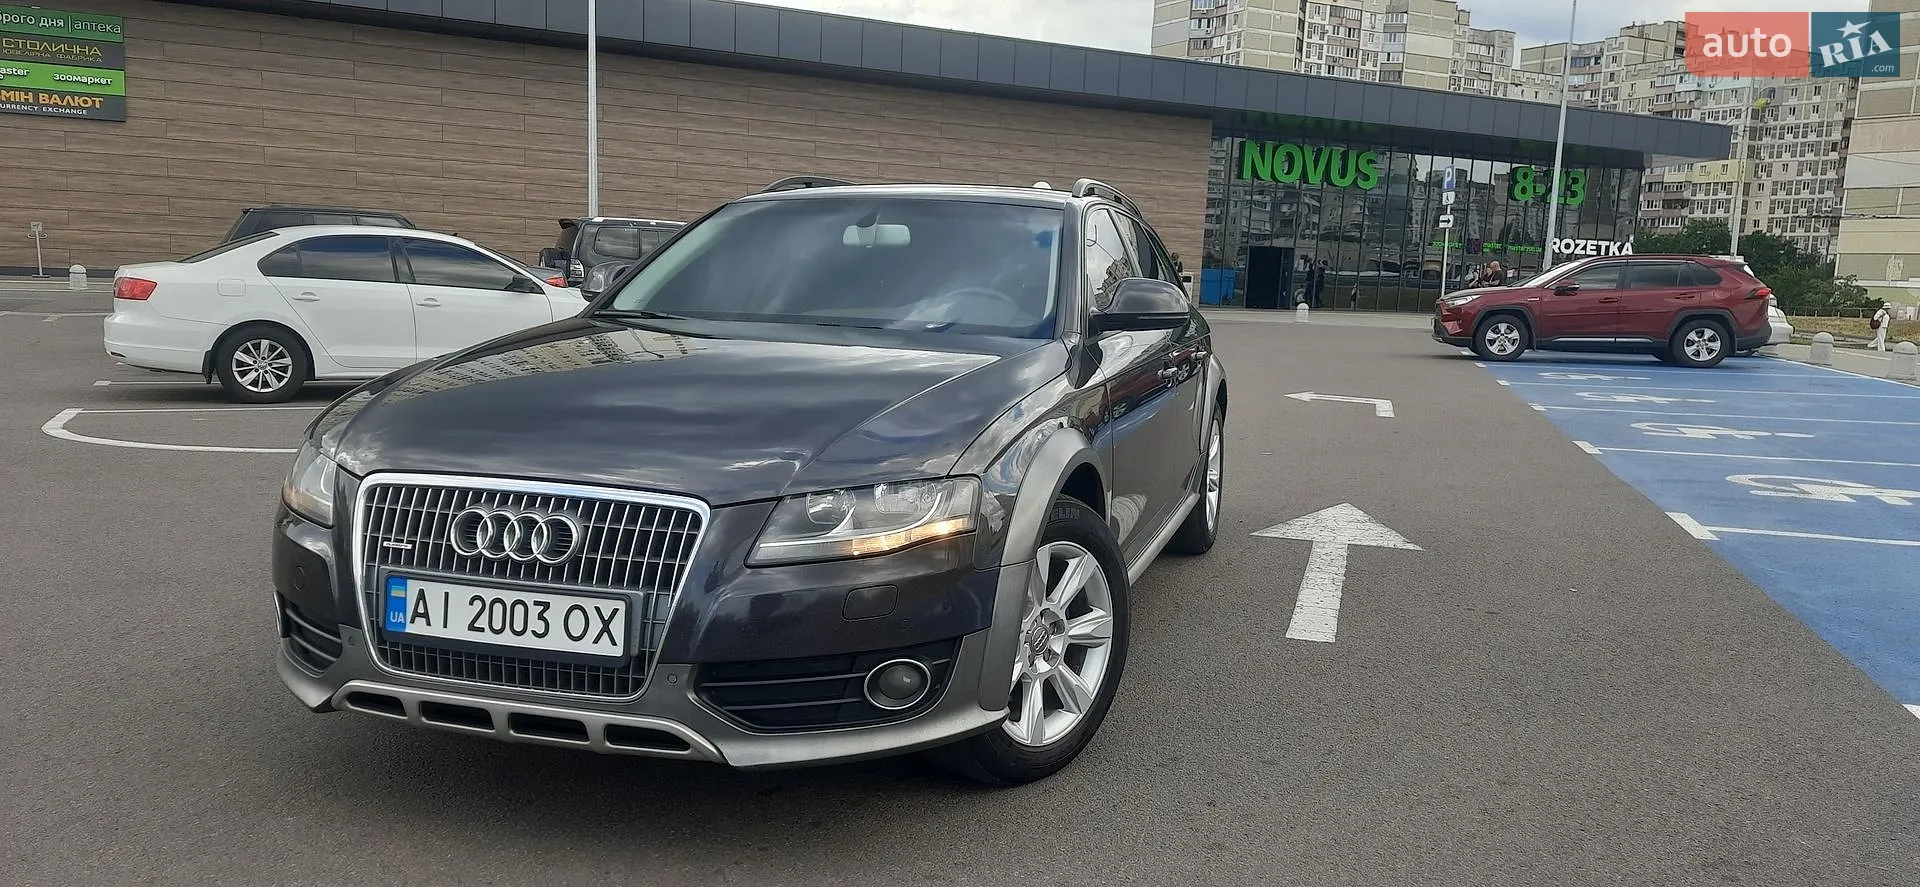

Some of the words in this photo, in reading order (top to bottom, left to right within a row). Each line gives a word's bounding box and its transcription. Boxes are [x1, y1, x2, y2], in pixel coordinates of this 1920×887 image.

[0, 12, 36, 25] рого
[39, 17, 65, 28] дня
[74, 20, 121, 33] аптека
[2, 38, 103, 57] СТОЛИЧНА
[53, 73, 112, 85] зоомаркет
[39, 93, 104, 109] ВАЛЮТ
[43, 106, 88, 115] EXCHANGE
[1241, 139, 1379, 191] NOVUS
[1444, 167, 1453, 190] P
[1552, 237, 1634, 256] ROZETKA
[389, 611, 406, 624] UA
[409, 588, 450, 629] AI
[467, 594, 551, 639] 2003
[563, 603, 620, 646] OX
